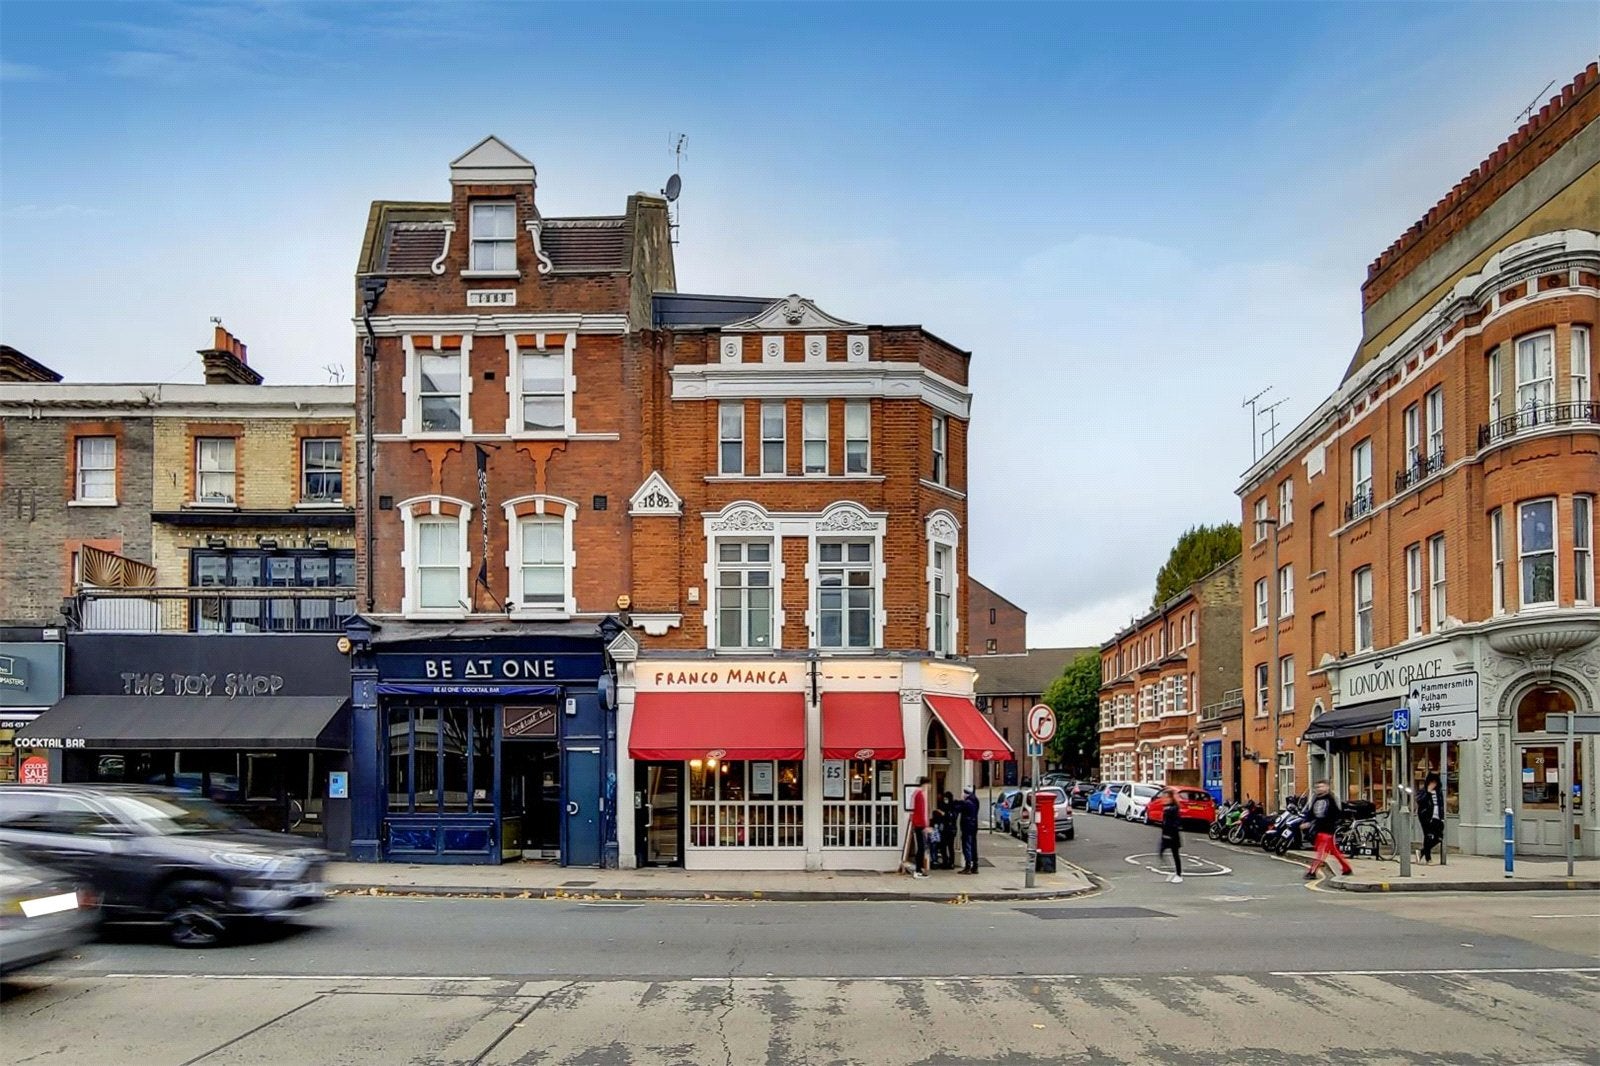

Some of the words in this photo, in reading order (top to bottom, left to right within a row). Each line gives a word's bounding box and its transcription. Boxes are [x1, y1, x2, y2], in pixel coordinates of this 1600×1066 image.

[643, 492, 669, 508] 1889
[425, 660, 453, 678] BE
[465, 660, 493, 678] AT
[502, 660, 555, 678] ONE
[655, 671, 718, 685] FRANCO
[726, 669, 788, 684] MANCA
[1349, 669, 1395, 696] LONDON
[121, 672, 165, 696] THE
[171, 673, 217, 697] TOY
[225, 673, 284, 699] SHOP
[1421, 678, 1474, 691] Hammersmith
[1421, 693, 1448, 701] Fulham
[1421, 702, 1440, 712] A219
[1430, 720, 1456, 728] Barnes
[1430, 729, 1452, 738] B306
[14, 738, 63, 748] COCKTAIL
[65, 738, 86, 748] BAR
[25, 769, 48, 778] SALE
[827, 767, 841, 778] £5
